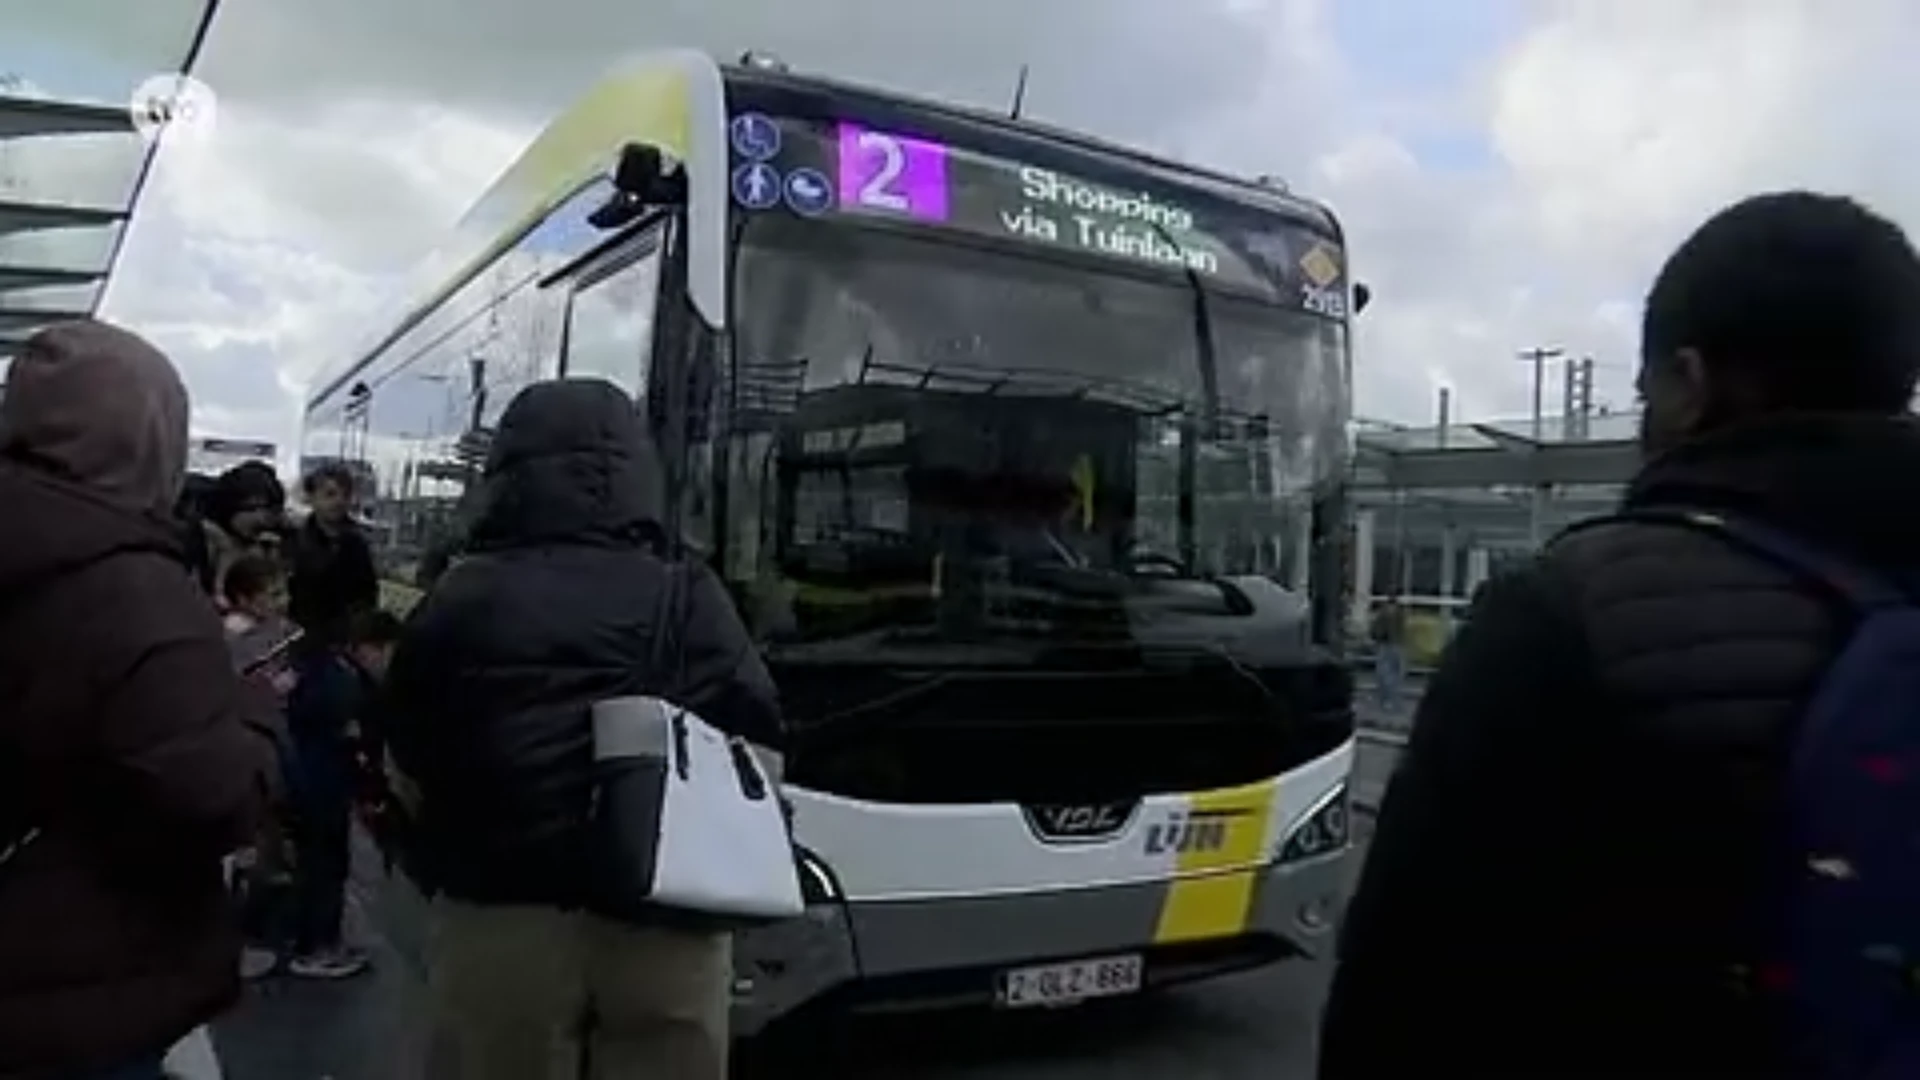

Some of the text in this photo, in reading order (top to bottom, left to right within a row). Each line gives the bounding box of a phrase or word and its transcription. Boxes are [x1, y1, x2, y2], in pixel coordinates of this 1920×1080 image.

[860, 131, 908, 209] 2
[1020, 166, 1193, 230] Shopping
[1001, 206, 1057, 240] via
